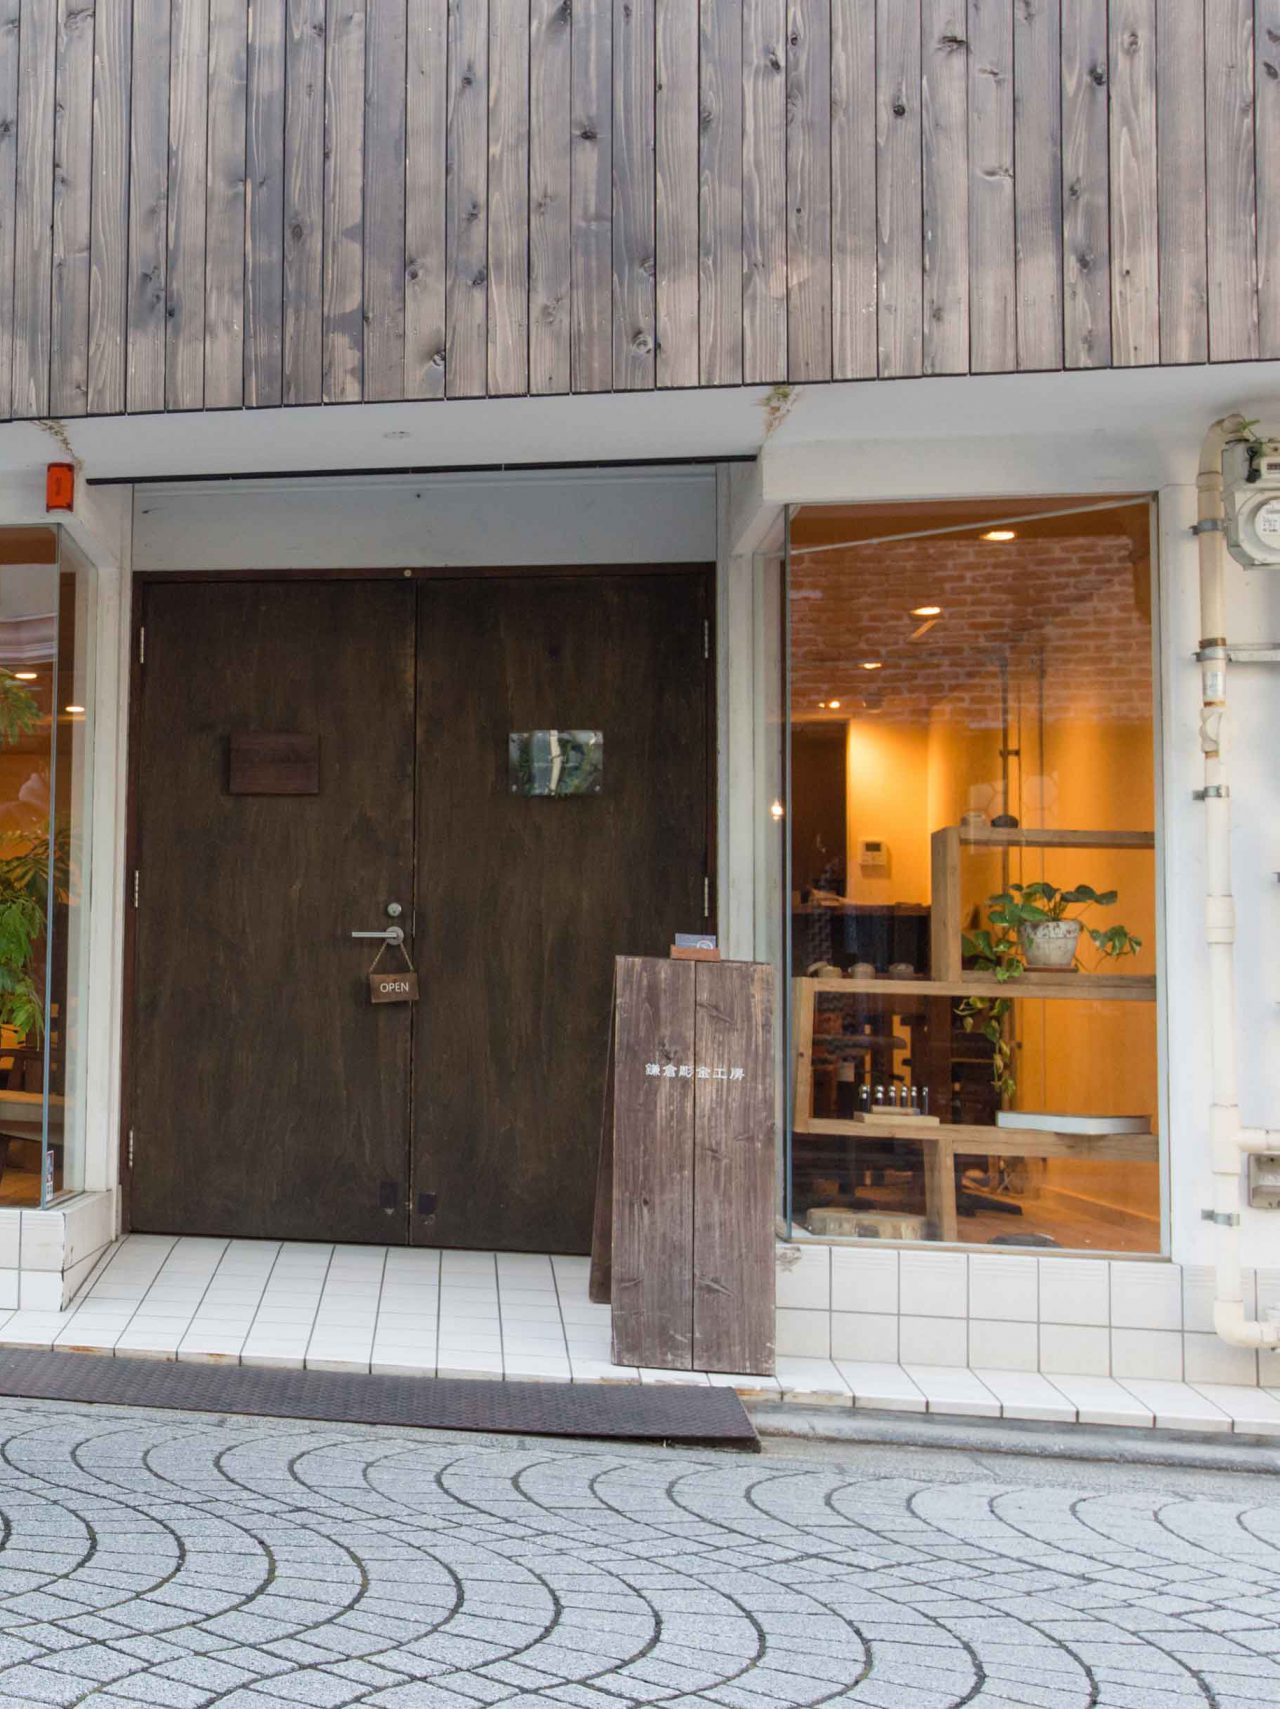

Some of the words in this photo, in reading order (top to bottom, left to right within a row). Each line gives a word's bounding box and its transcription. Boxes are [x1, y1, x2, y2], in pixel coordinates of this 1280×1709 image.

[380, 982, 409, 993] OPEN
[644, 1063, 745, 1081] 鎌倉彫金工房
